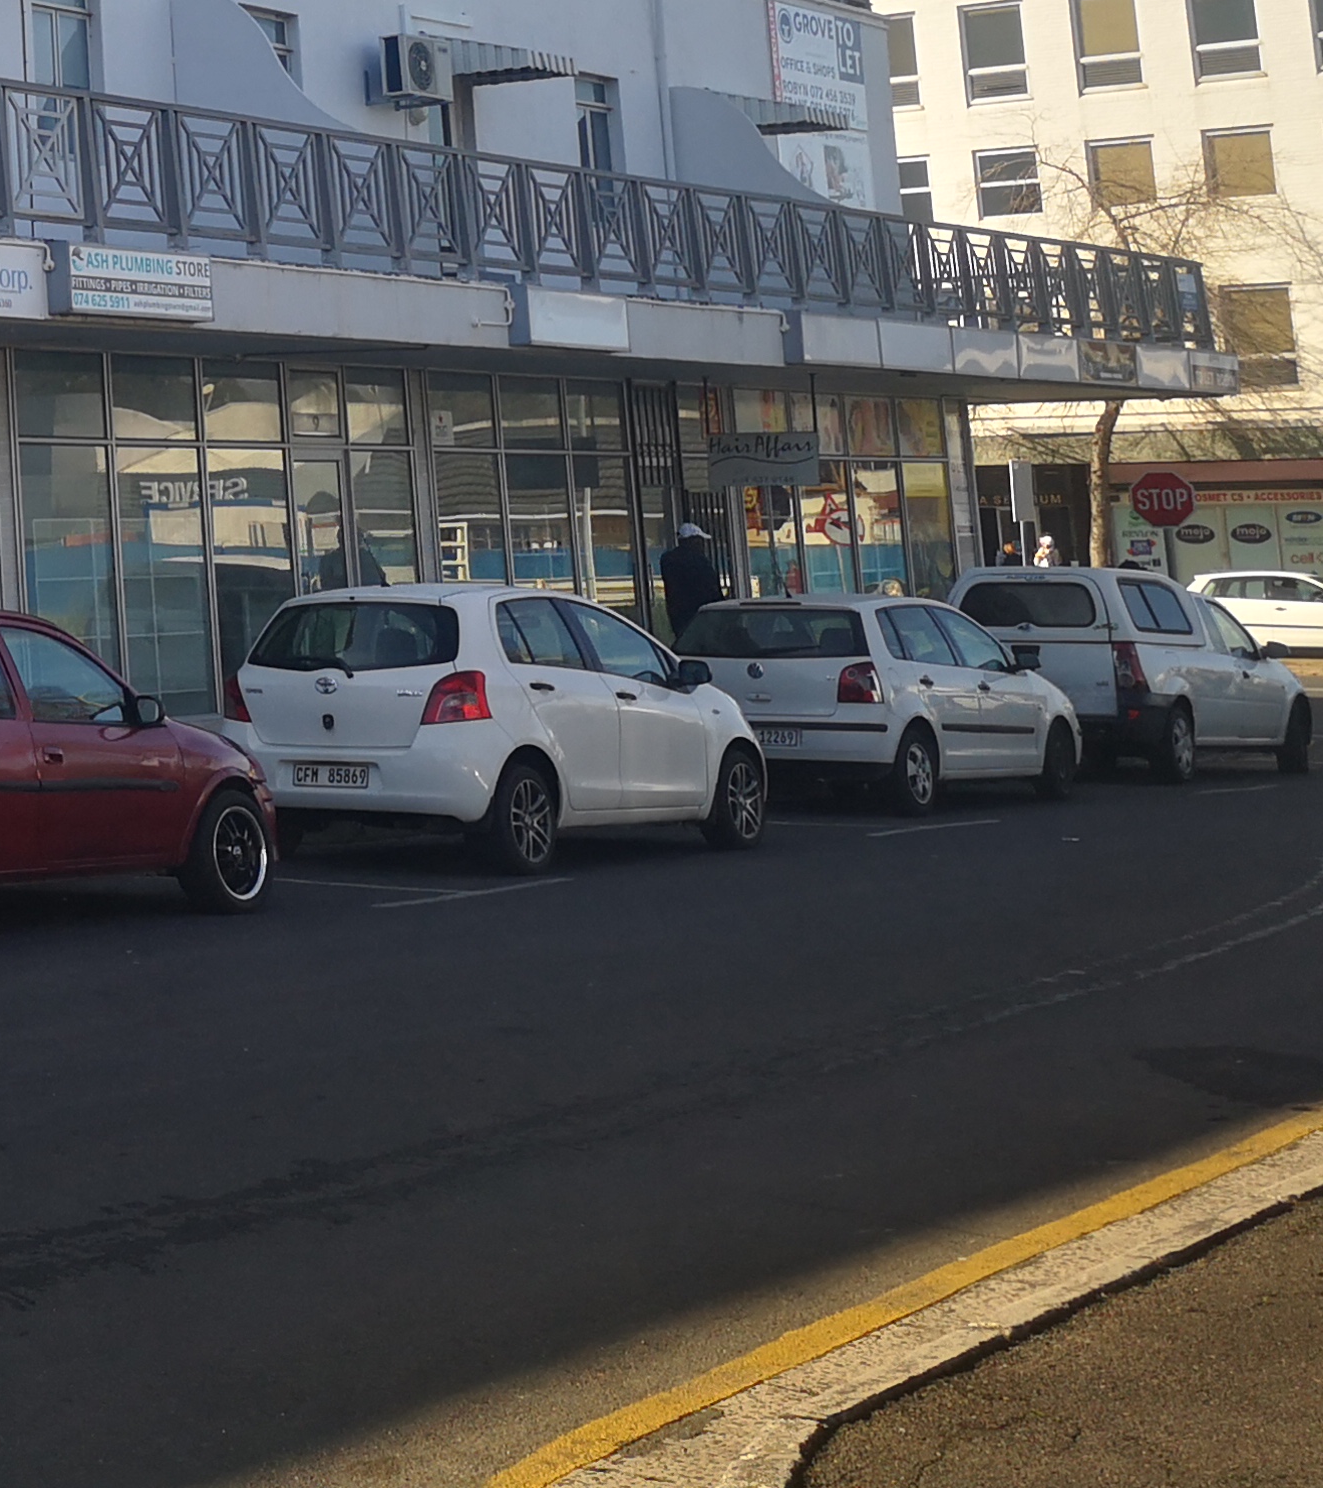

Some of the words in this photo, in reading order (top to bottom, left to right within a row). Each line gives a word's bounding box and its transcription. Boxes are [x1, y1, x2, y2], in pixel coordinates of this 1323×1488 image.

[793, 12, 834, 40] GROVE
[835, 21, 854, 47] TO
[781, 55, 806, 73] OFFICE
[812, 63, 837, 80] SHOPS
[838, 49, 861, 76] LET
[86, 252, 110, 270] ASH
[112, 254, 173, 275] PLUMBING
[175, 260, 210, 278] STORE
[72, 276, 105, 290] FITTINGS
[111, 280, 131, 292] PIPES
[136, 282, 179, 296] IRRIGATION
[184, 286, 211, 299] FILTERS
[73, 292, 88, 307] 074
[91, 293, 107, 308] 625
[109, 295, 131, 309] 5911
[312, 415, 320, 431] 9
[709, 437, 750, 454] Hair
[1137, 488, 1189, 511] STOP
[1254, 491, 1322, 501] ACCESSORIES
[1236, 526, 1267, 539] mojo
[759, 730, 794, 744] 12269
[296, 767, 319, 783] CFM
[327, 768, 366, 785] 85869
